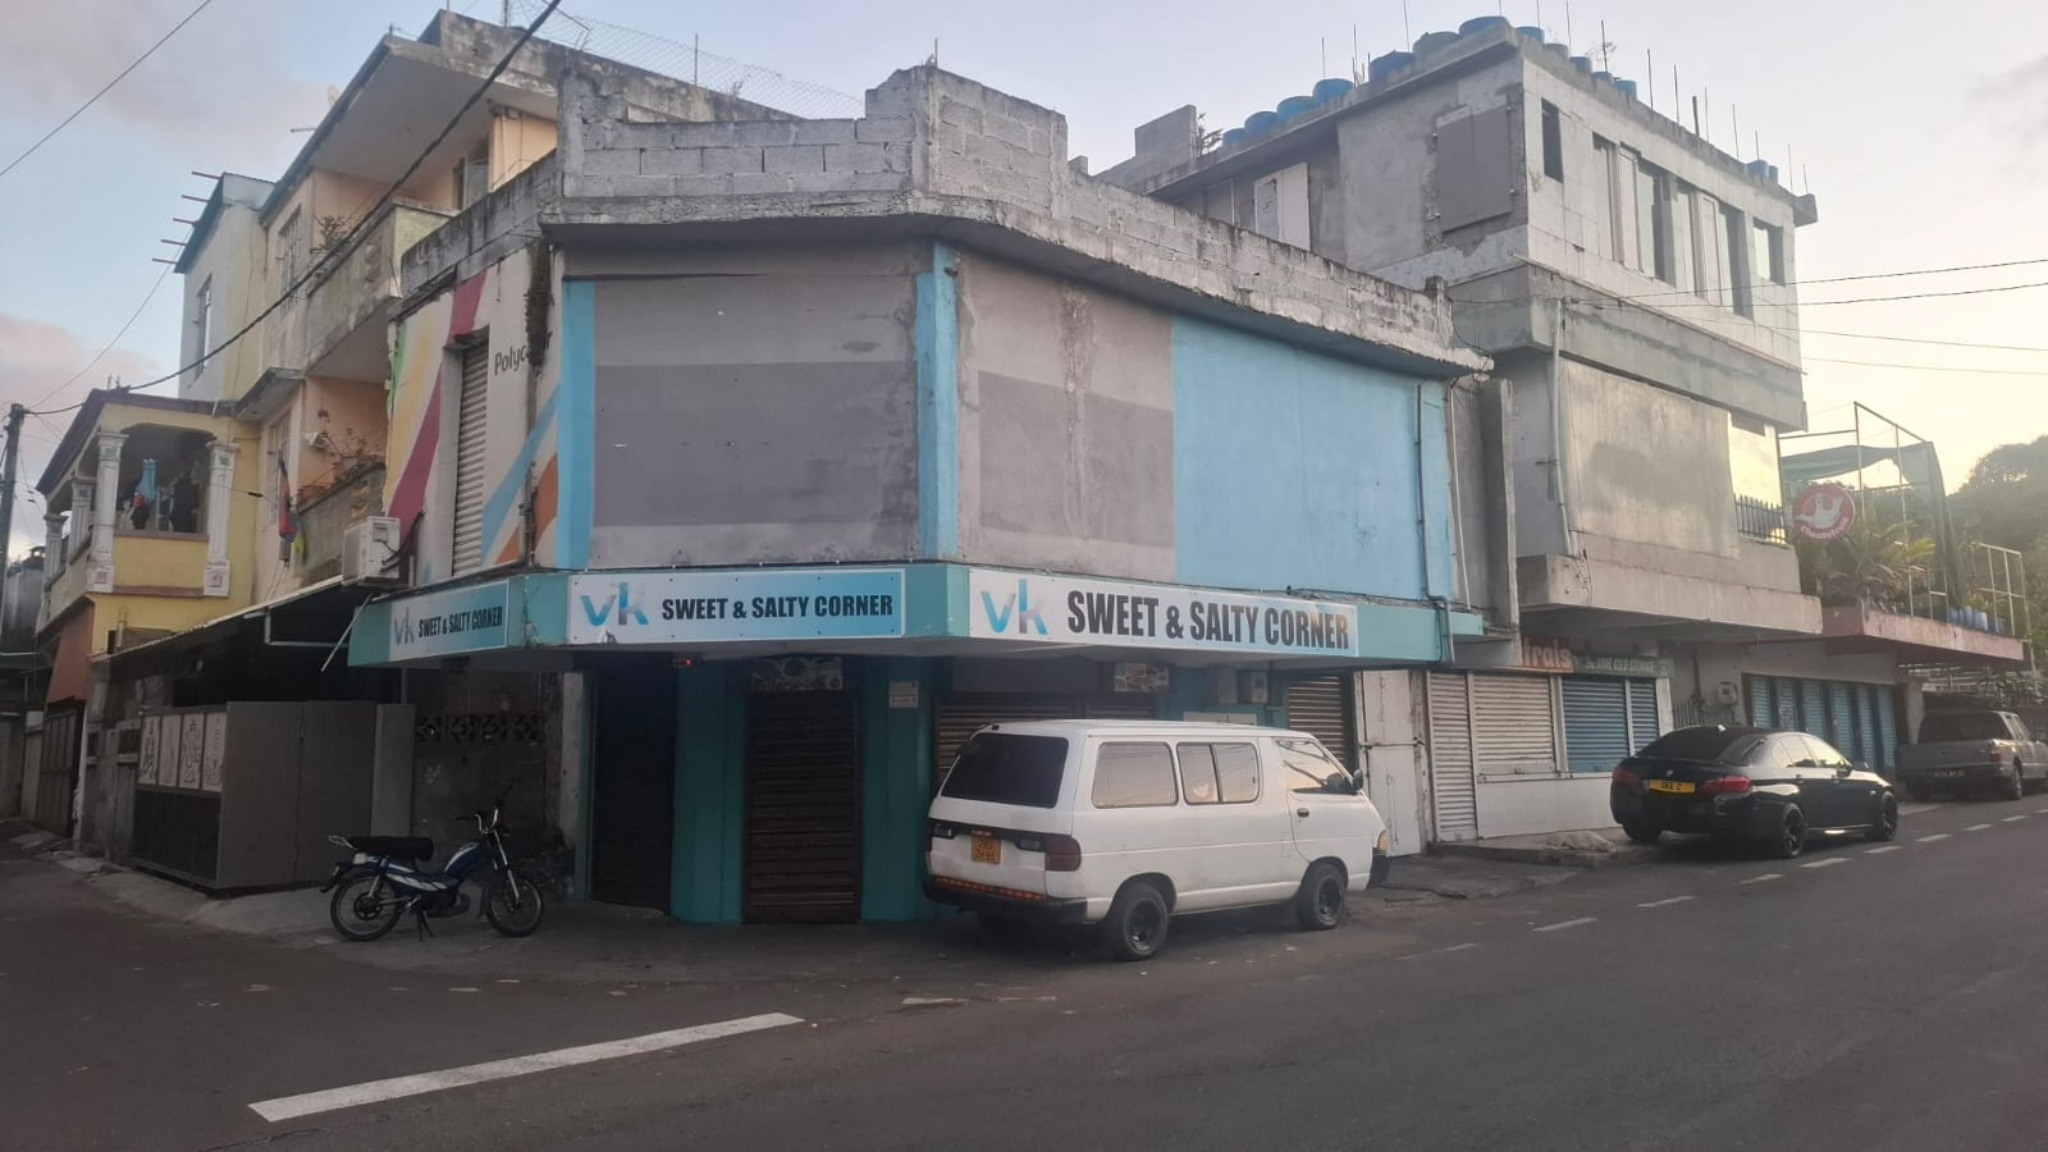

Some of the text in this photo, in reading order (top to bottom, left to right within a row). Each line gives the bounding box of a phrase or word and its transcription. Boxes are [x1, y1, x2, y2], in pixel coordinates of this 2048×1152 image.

[418, 606, 502, 638] SWEET & SALTY CORNER
[662, 594, 893, 620] SWEET & SALTY CORNER
[1067, 590, 1349, 649] SWEET & SALTY CORNER
